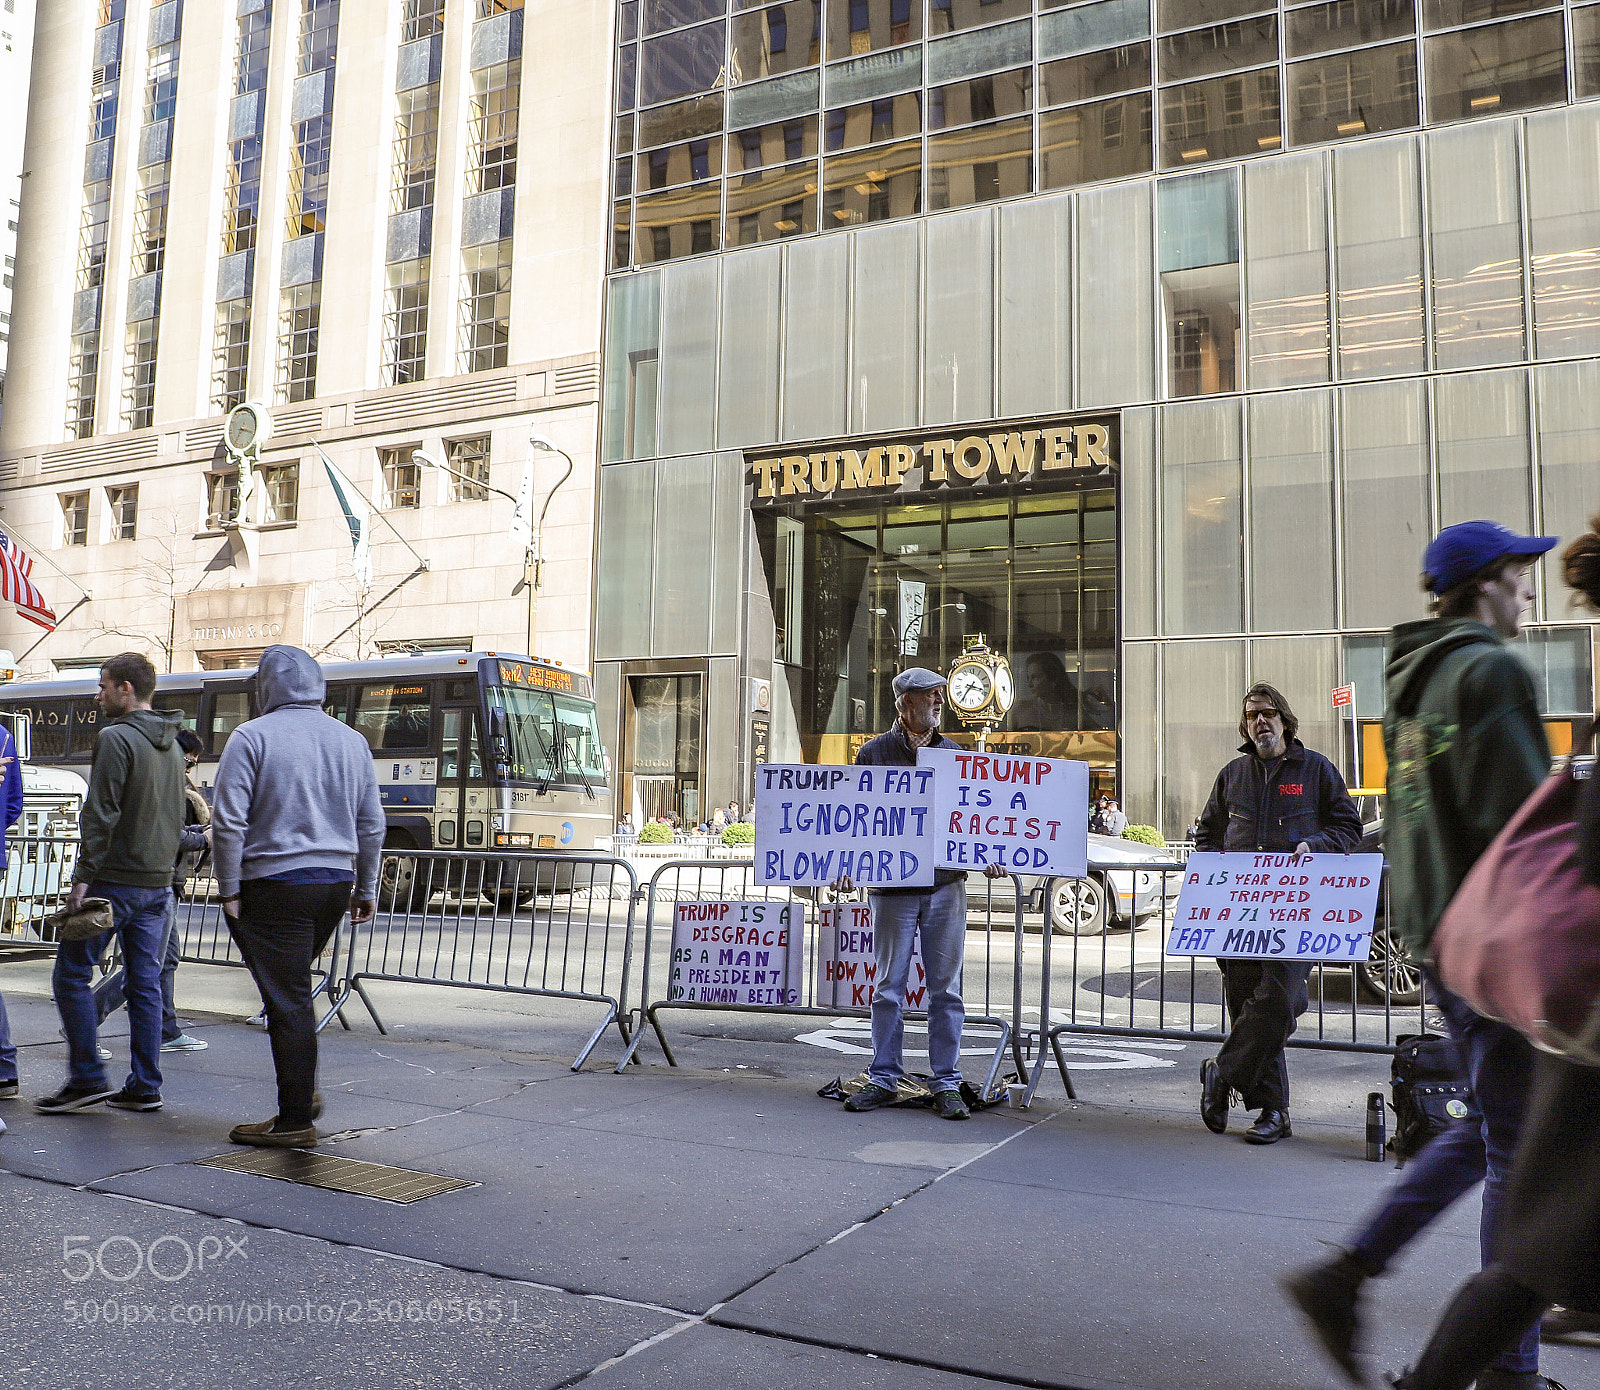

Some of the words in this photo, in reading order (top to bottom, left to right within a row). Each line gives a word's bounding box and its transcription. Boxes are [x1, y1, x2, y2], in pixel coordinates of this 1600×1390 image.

[753, 445, 917, 498] TRUMP
[923, 424, 1110, 481] TOWER
[194, 626, 244, 641] TIFFANY
[247, 625, 257, 639] &
[527, 675, 544, 687] PENN
[635, 758, 673, 769] GUCCI
[955, 755, 1052, 785] TRUMP
[858, 770, 873, 792] A
[884, 770, 934, 794] FAT
[511, 791, 528, 802] 3181
[958, 786, 992, 807] IS
[1010, 792, 1027, 810] A
[779, 802, 928, 838] IGNORANT
[948, 810, 1061, 841] RACIST
[1253, 855, 1314, 868] TRUMP
[1188, 872, 1200, 885] A
[1206, 871, 1229, 886] 15
[1235, 873, 1270, 886] YEAR
[1279, 875, 1309, 886] OLD
[1320, 875, 1371, 888] MIND
[1230, 890, 1311, 903] TRAPPED
[679, 904, 730, 922] TRUMP
[740, 906, 767, 924] IS
[780, 906, 790, 924] A
[1188, 907, 1211, 921] IN
[1217, 908, 1231, 921] A
[1237, 907, 1259, 922] 71
[1269, 908, 1312, 922] YEAR
[1322, 909, 1363, 924] OLD
[692, 926, 788, 948] DISGRACE
[1176, 927, 1216, 951] FAT
[1222, 926, 1287, 955] MAN'S
[1297, 931, 1362, 956] BODY
[674, 948, 692, 963] AS
[700, 950, 709, 963] A
[719, 948, 770, 967] MAN
[673, 967, 681, 980] A
[689, 968, 780, 985] PRESIDENT
[826, 961, 858, 982] HOW
[688, 987, 695, 1000] A
[701, 987, 738, 1003] HUMAN
[748, 988, 798, 1004] BEING
